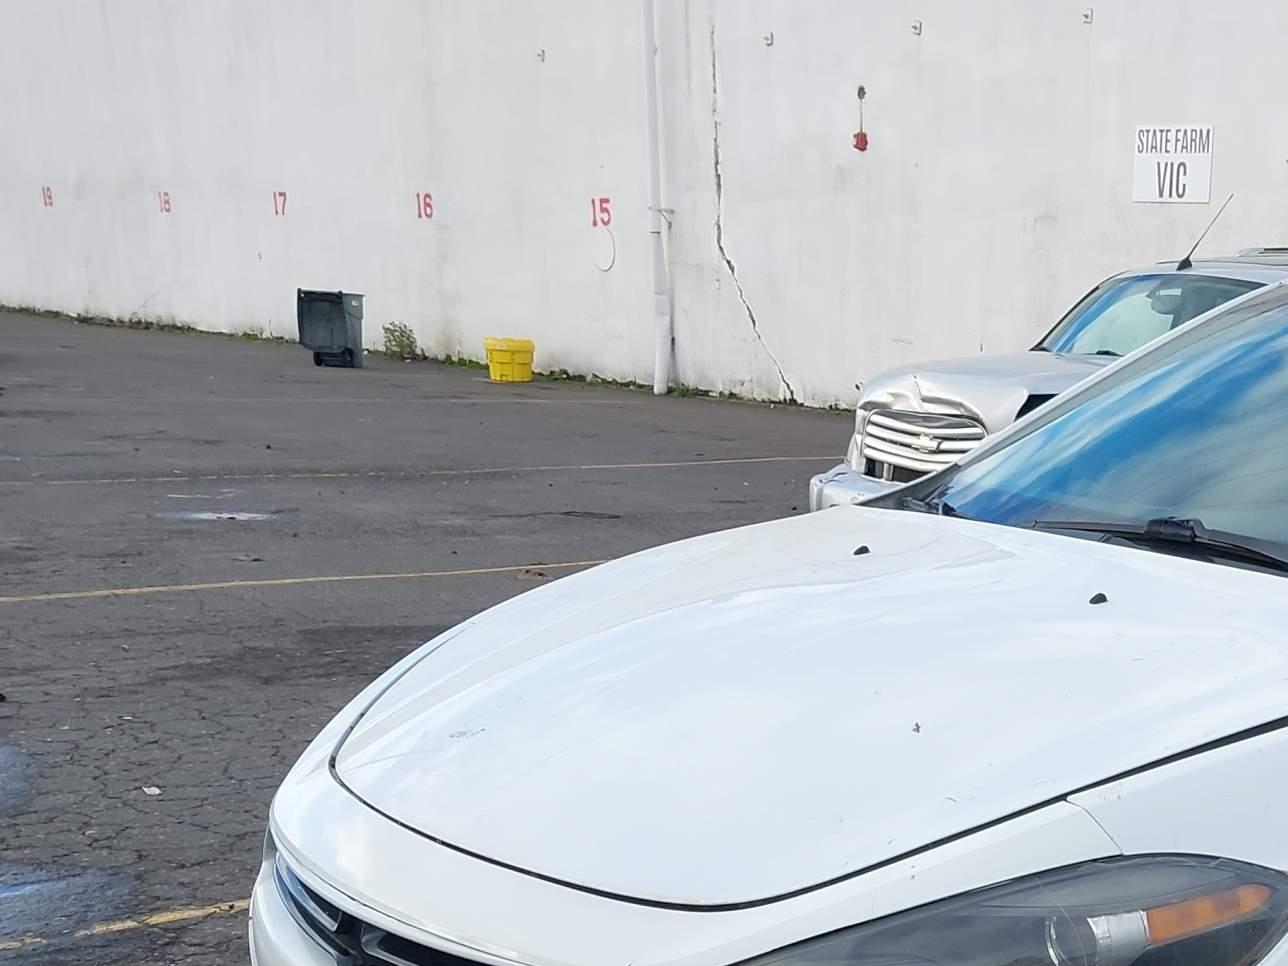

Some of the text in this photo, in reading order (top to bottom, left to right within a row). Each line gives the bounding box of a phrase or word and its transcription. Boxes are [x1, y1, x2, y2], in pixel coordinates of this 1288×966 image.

[1137, 127, 1210, 154] STATE FARM
[1156, 161, 1188, 199] VIC
[158, 191, 171, 213] 18
[272, 191, 287, 216] 17
[416, 192, 434, 219] 16
[591, 198, 612, 227] 15
